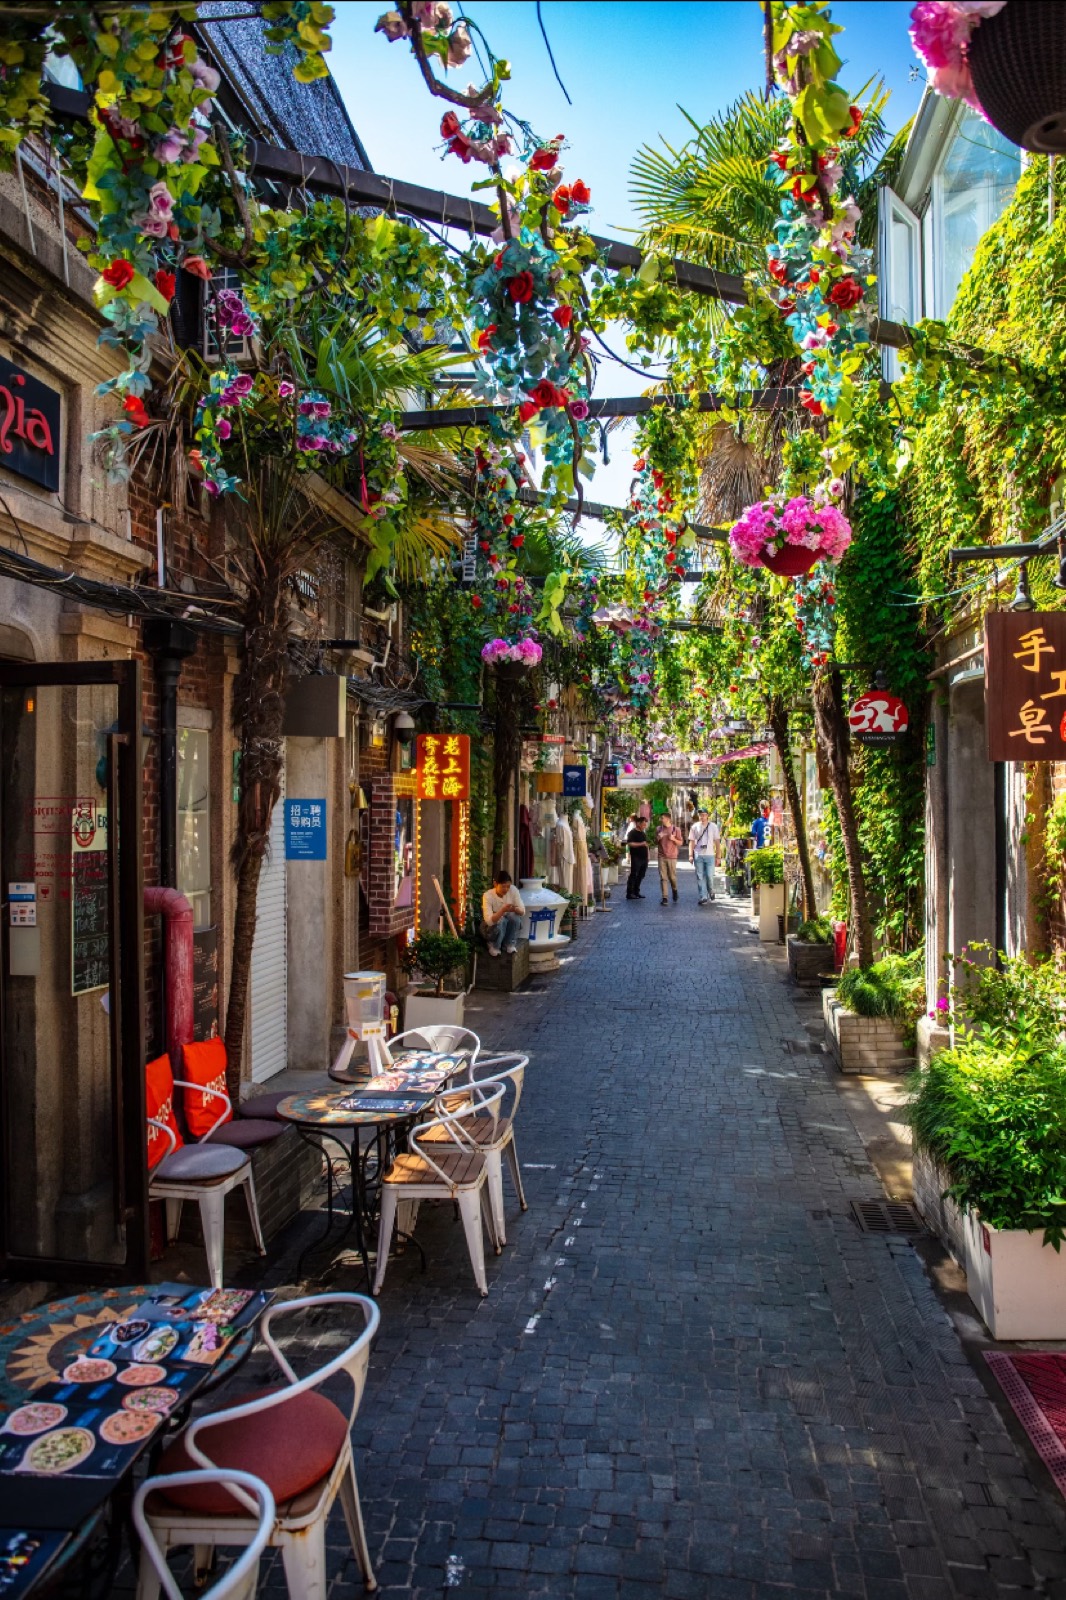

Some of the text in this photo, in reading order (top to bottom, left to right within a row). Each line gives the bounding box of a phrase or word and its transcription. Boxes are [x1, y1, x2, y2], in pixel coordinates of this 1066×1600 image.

[442, 736, 463, 797] 老上海
[290, 817, 322, 828] 导购员
